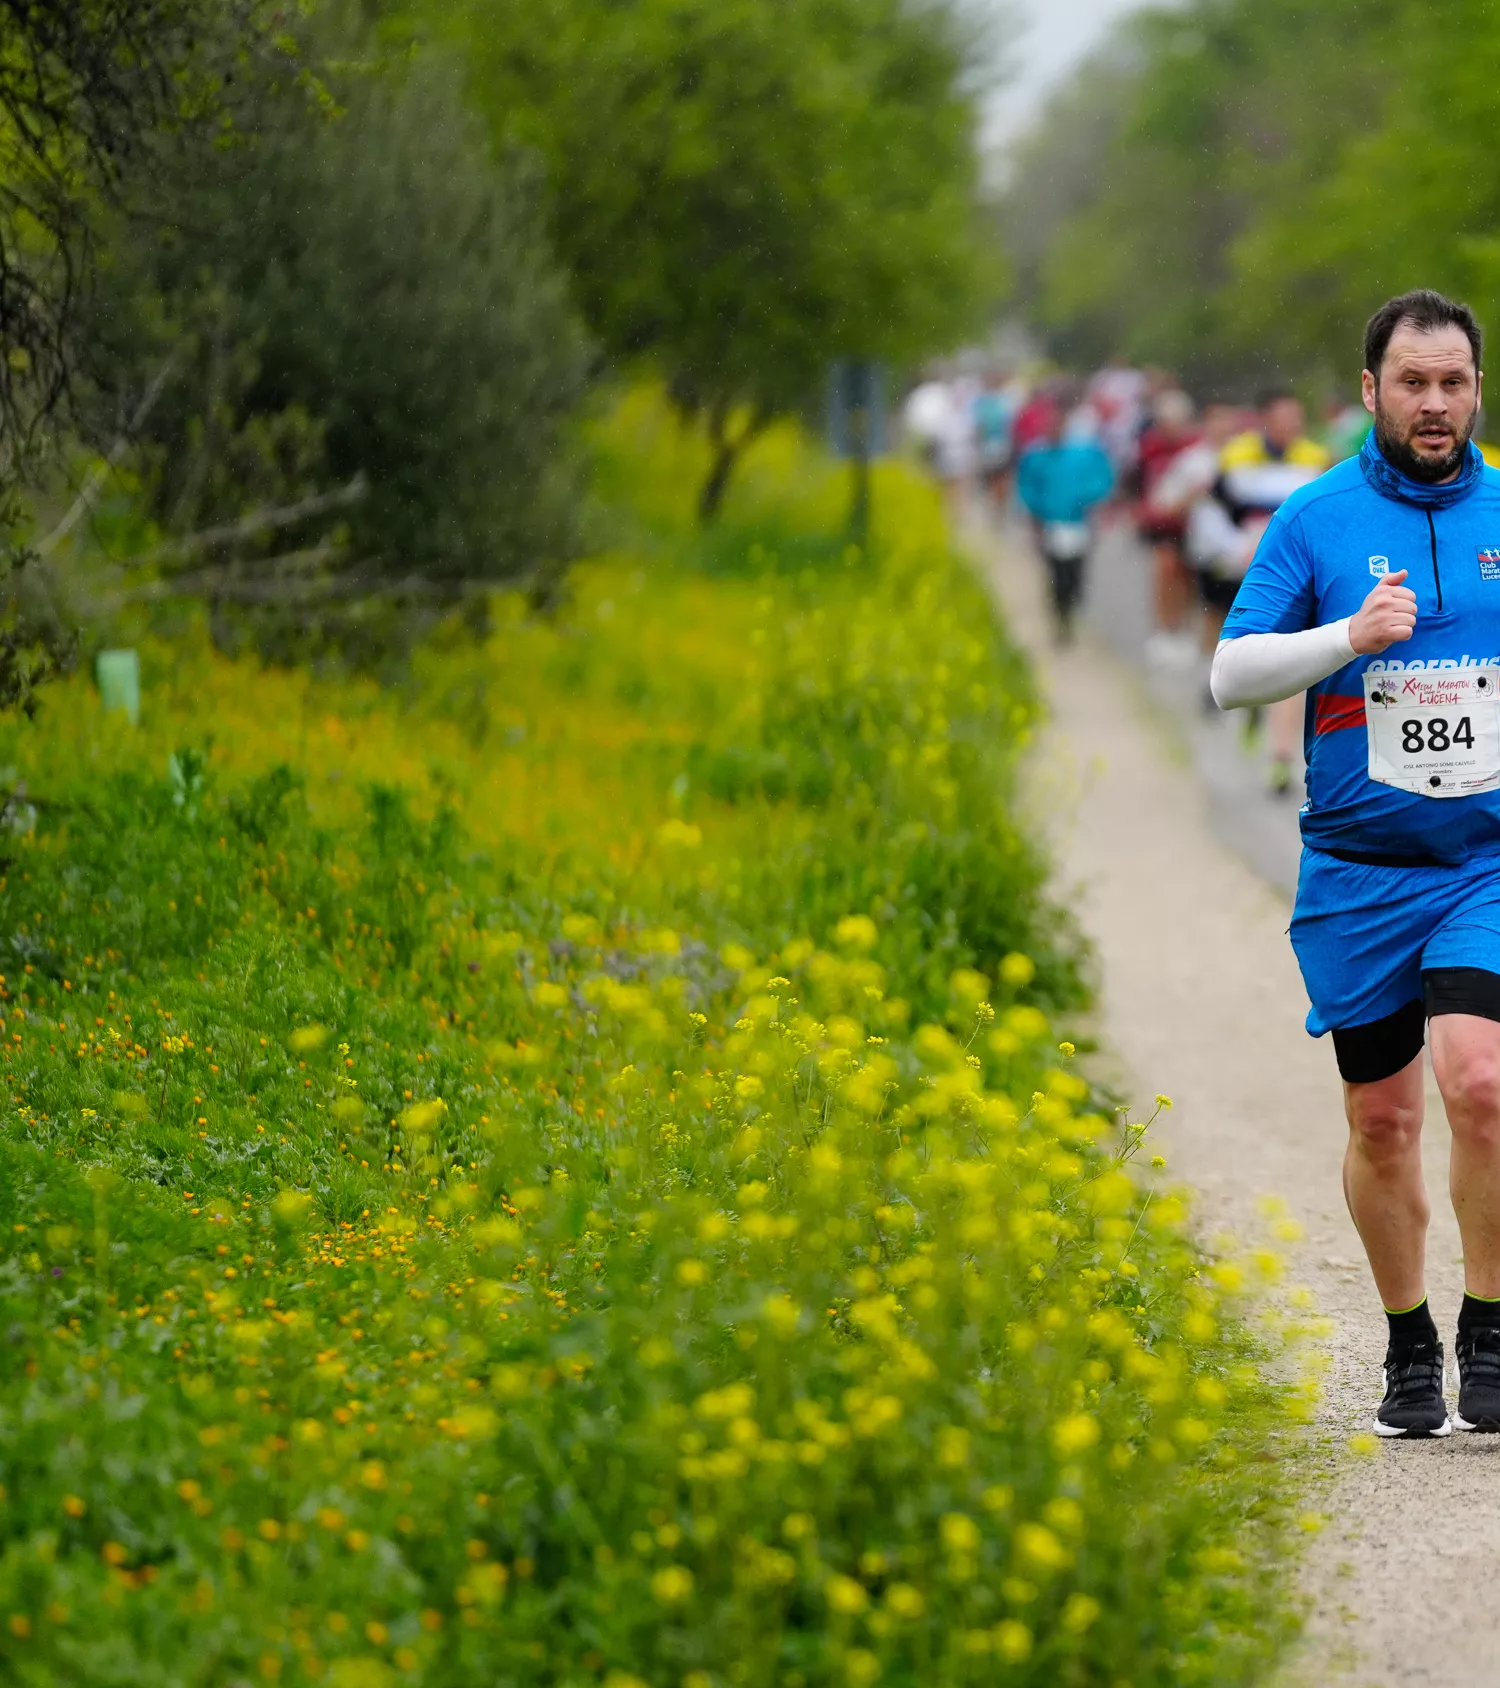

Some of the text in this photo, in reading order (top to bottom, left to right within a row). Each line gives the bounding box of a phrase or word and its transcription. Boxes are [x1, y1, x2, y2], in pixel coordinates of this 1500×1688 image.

[1372, 566, 1386, 574] OVAL
[1402, 677, 1417, 696] X
[1419, 692, 1463, 705] LUCENA
[1401, 716, 1475, 754] 884
